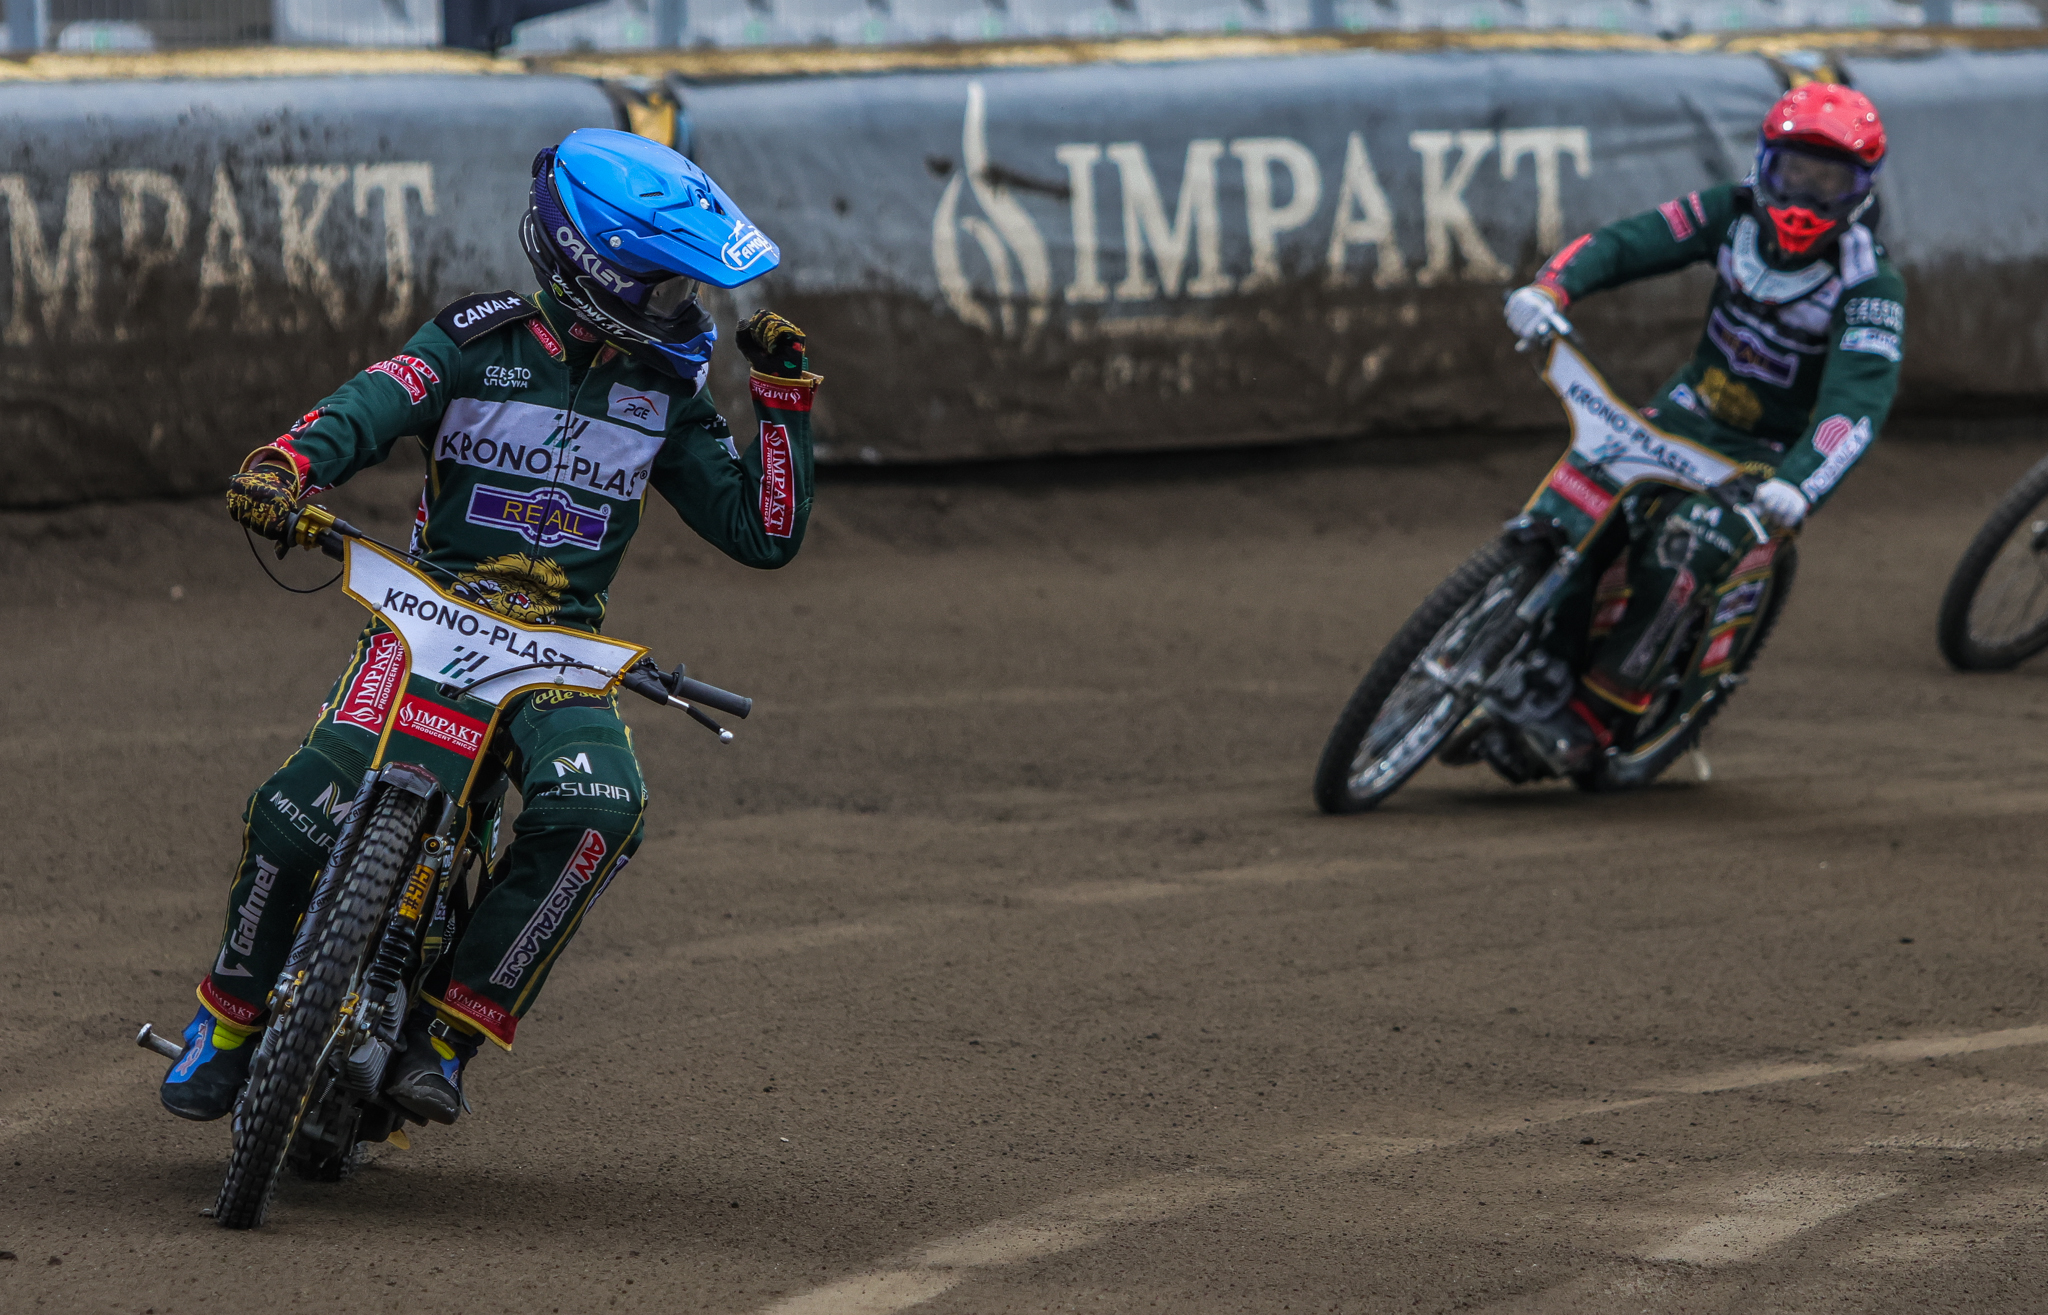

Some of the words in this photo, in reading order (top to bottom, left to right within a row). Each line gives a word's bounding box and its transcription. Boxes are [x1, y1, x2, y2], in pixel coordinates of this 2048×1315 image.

[1056, 126, 1592, 302] IMPAKT
[556, 226, 635, 294] OAKLEY
[453, 296, 521, 329] CANAL+
[623, 403, 650, 420] PGE
[770, 449, 787, 530] IMPAKT
[378, 663, 400, 710] PRODUCENT
[411, 723, 451, 742] PRODUCENT
[451, 738, 477, 752] ZNICZY
[414, 709, 483, 745] IMPAKT
[536, 782, 631, 803] ASURIA
[230, 854, 279, 956] Galmet
[457, 994, 506, 1022] IMPAKT
